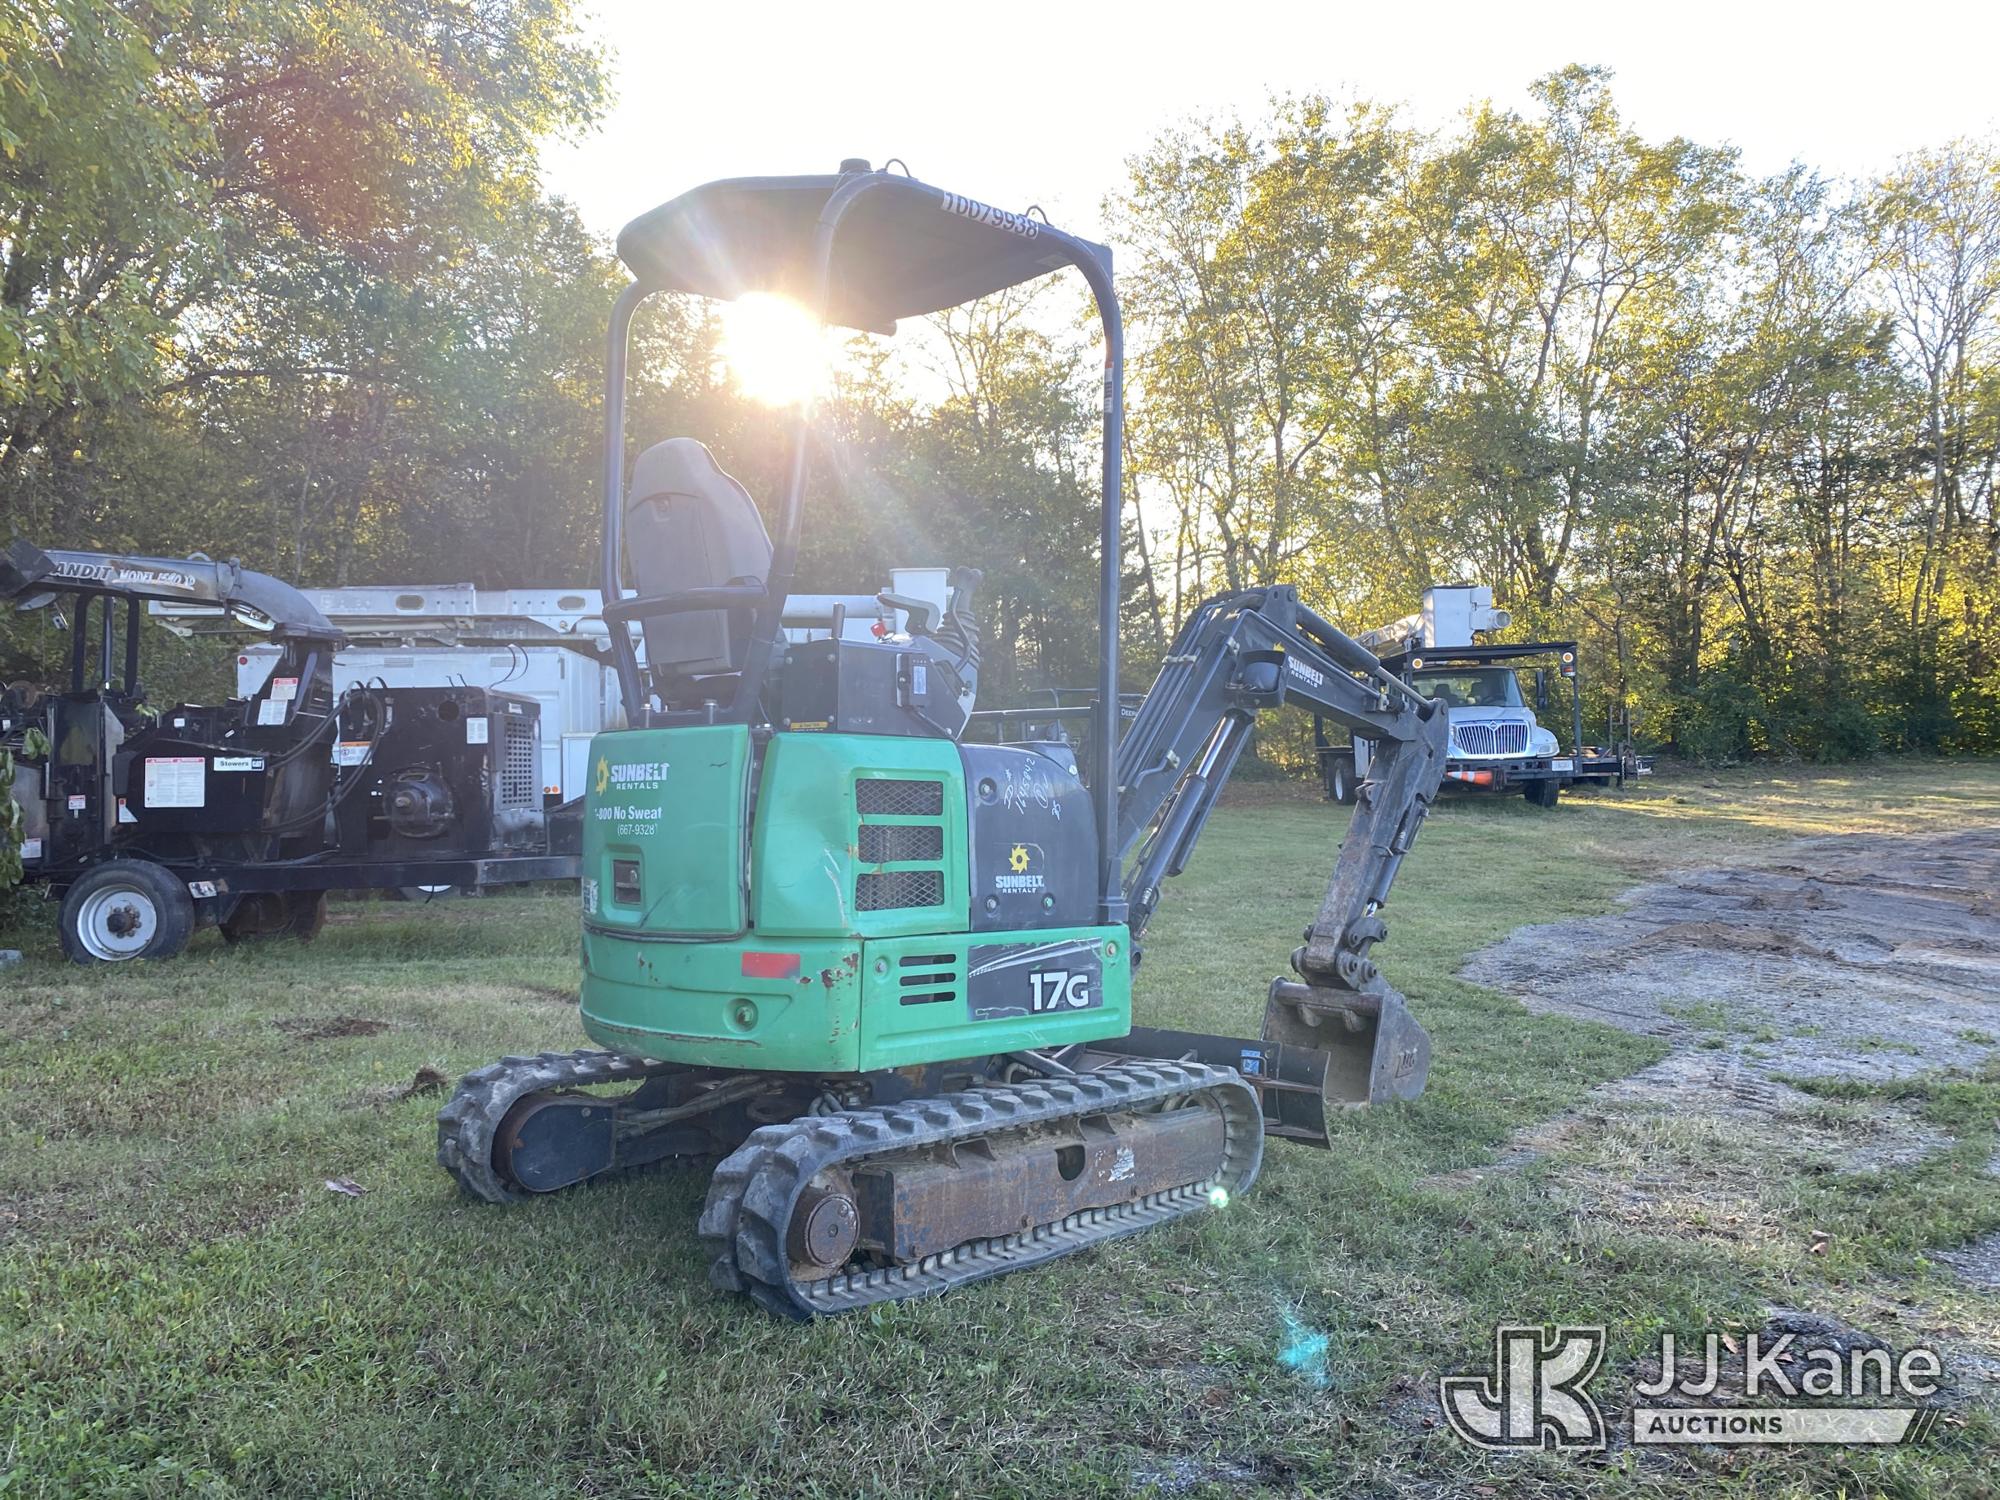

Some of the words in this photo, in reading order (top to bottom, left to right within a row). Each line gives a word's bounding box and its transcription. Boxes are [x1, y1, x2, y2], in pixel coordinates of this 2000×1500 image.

[52, 561, 112, 580] ANDIT
[119, 569, 155, 584] MODEL
[1288, 655, 1323, 685] SUNBELT
[1290, 669, 1318, 688] RENTALS
[610, 763, 670, 782] SUNBELT
[616, 782, 659, 790] RENTALS
[613, 806, 626, 820] No
[628, 805, 662, 820] Sweat
[995, 875, 1045, 888] SUNBELT
[1030, 971, 1089, 1011] 17G
